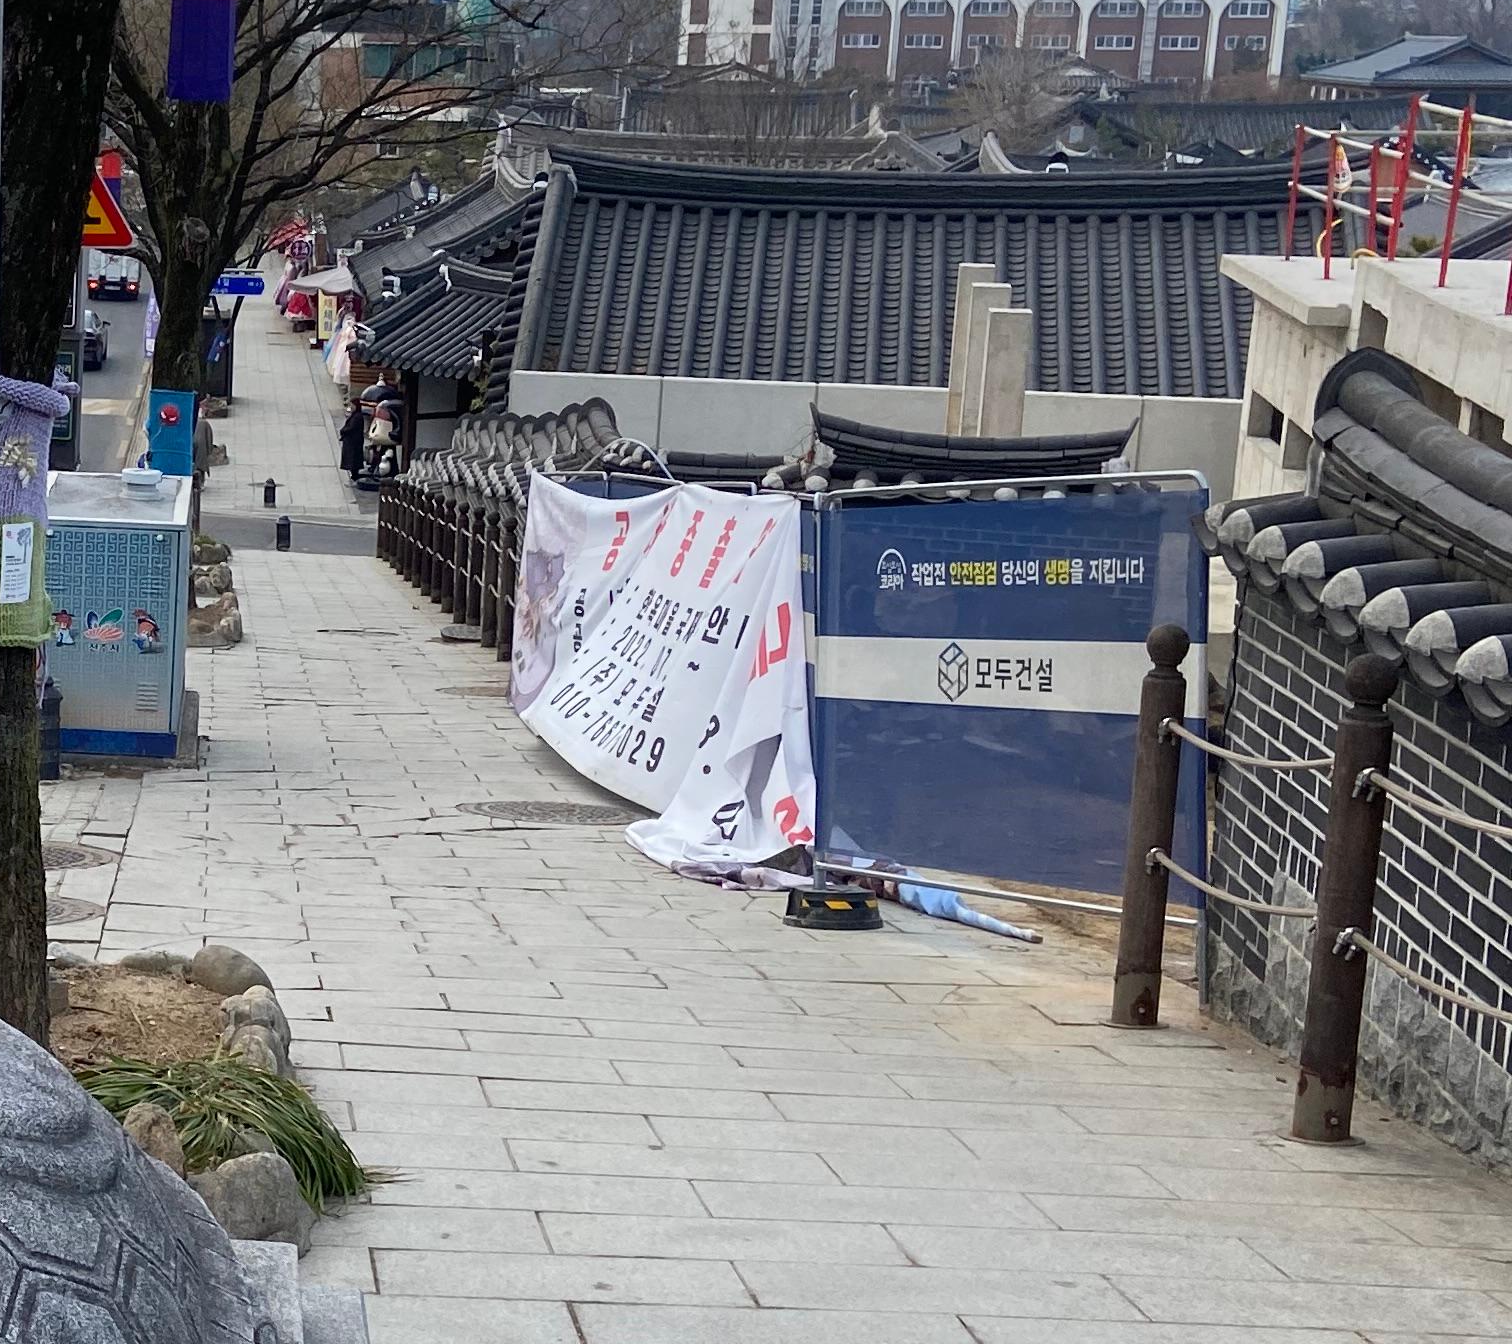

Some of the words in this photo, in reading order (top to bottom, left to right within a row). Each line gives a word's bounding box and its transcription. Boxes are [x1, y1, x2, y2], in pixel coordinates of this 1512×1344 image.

[879, 574, 905, 591] 코리아
[911, 561, 946, 587] 작업전
[949, 559, 997, 586] 안전점검
[1001, 559, 1039, 586] 당신의
[1044, 558, 1084, 585] 생명을
[1089, 557, 1145, 585] 지킵니다
[974, 657, 1054, 693] 모두건설
